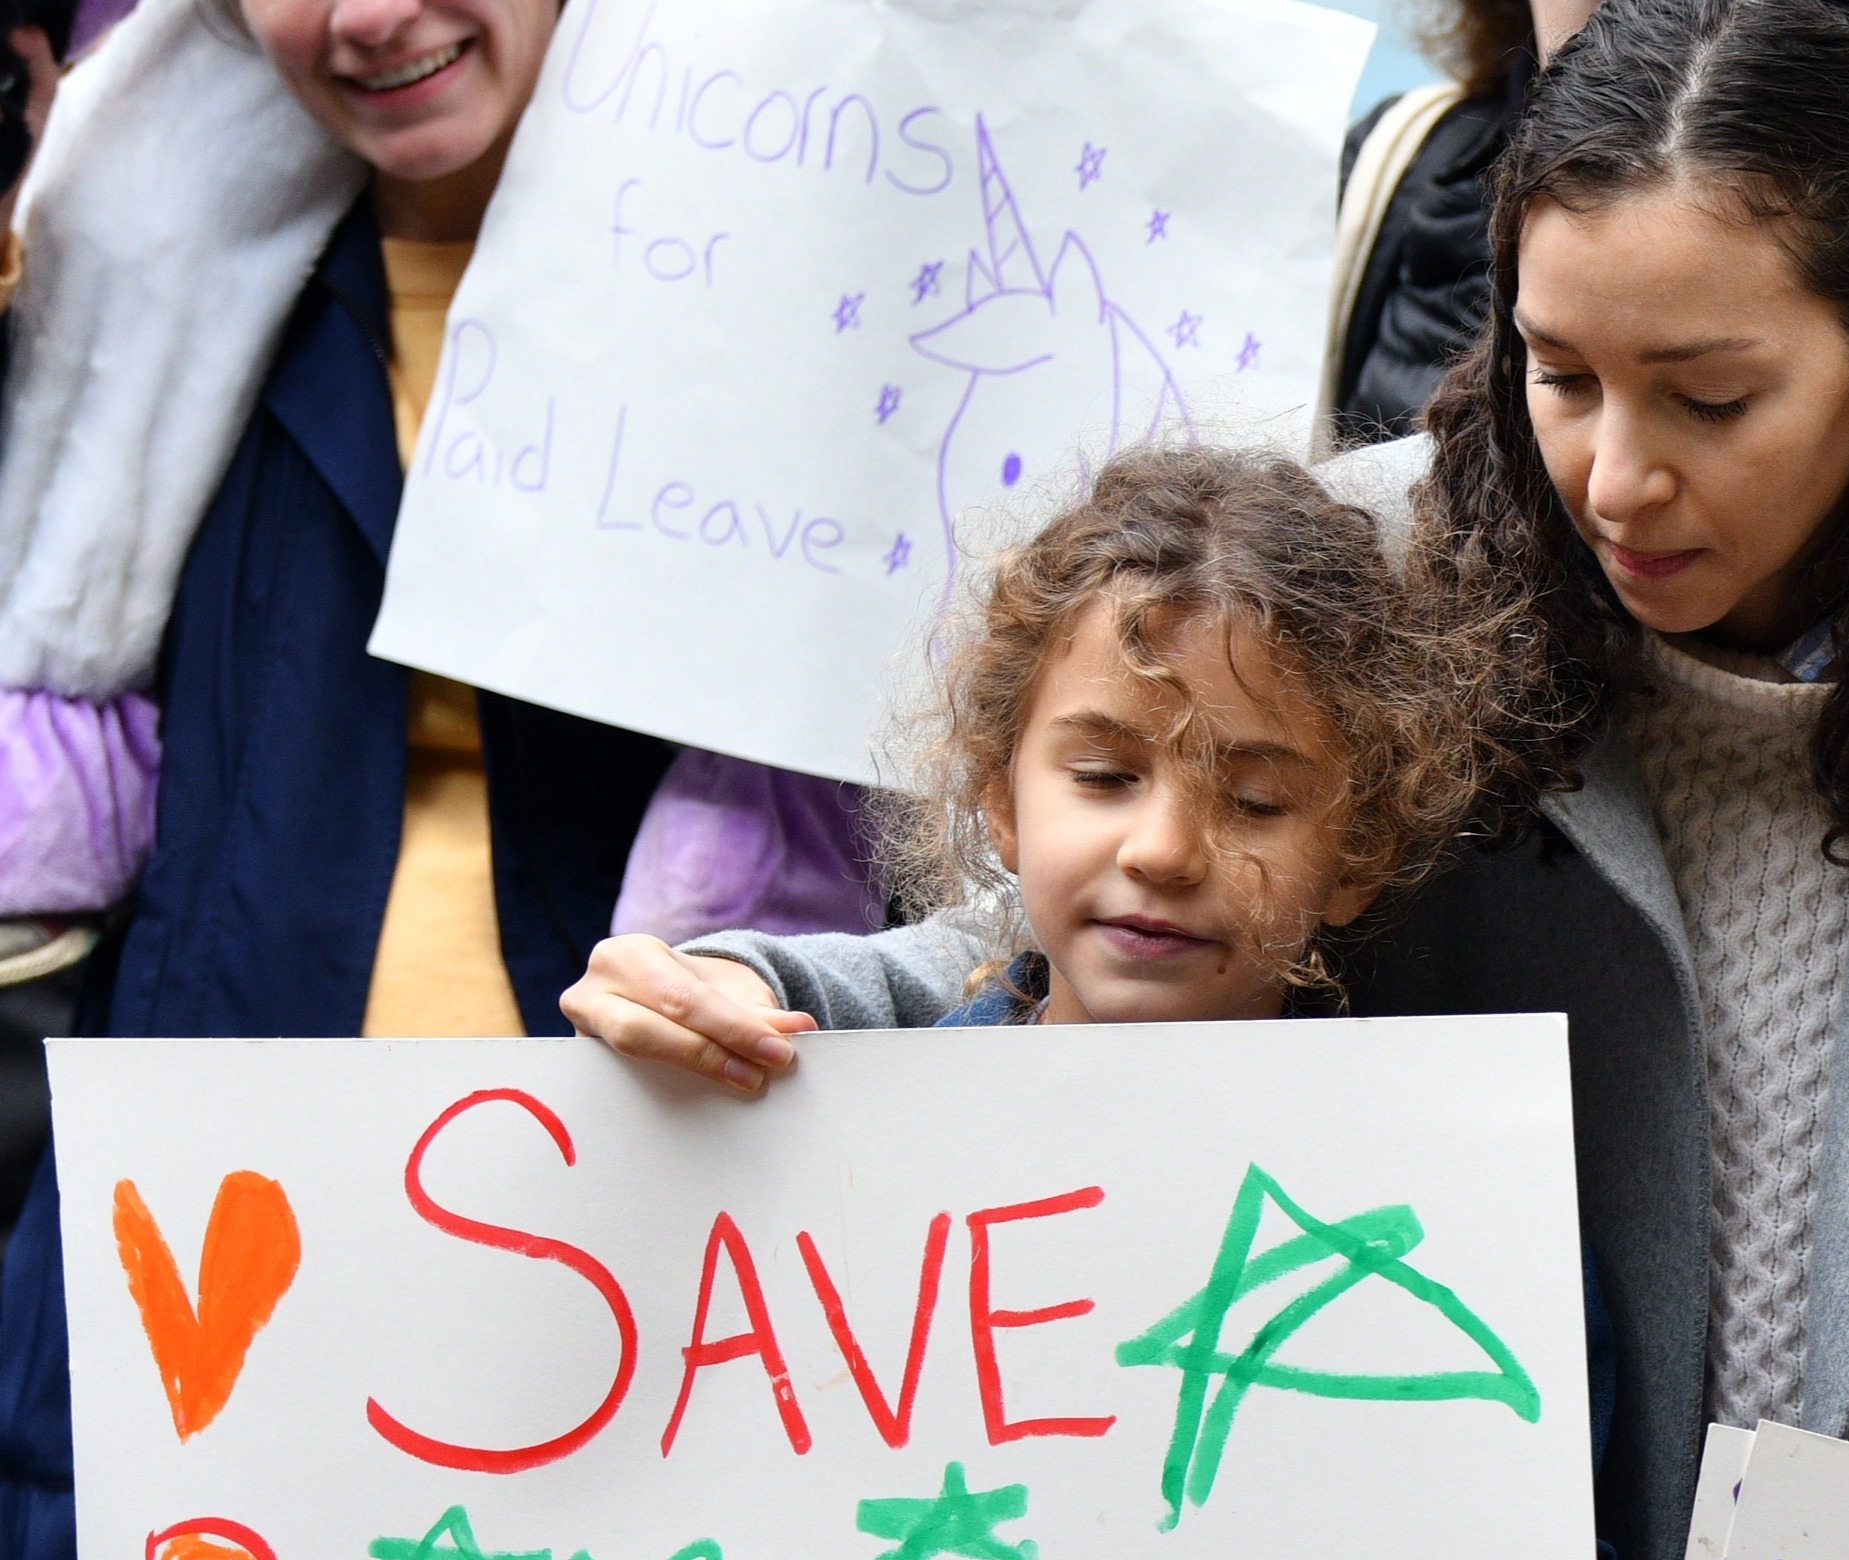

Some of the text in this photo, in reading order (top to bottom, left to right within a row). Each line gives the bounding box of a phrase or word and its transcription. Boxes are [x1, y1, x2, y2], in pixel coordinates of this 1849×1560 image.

[561, 0, 954, 196] Unicorns
[609, 177, 731, 287] for
[423, 318, 847, 575] Paid Leave
